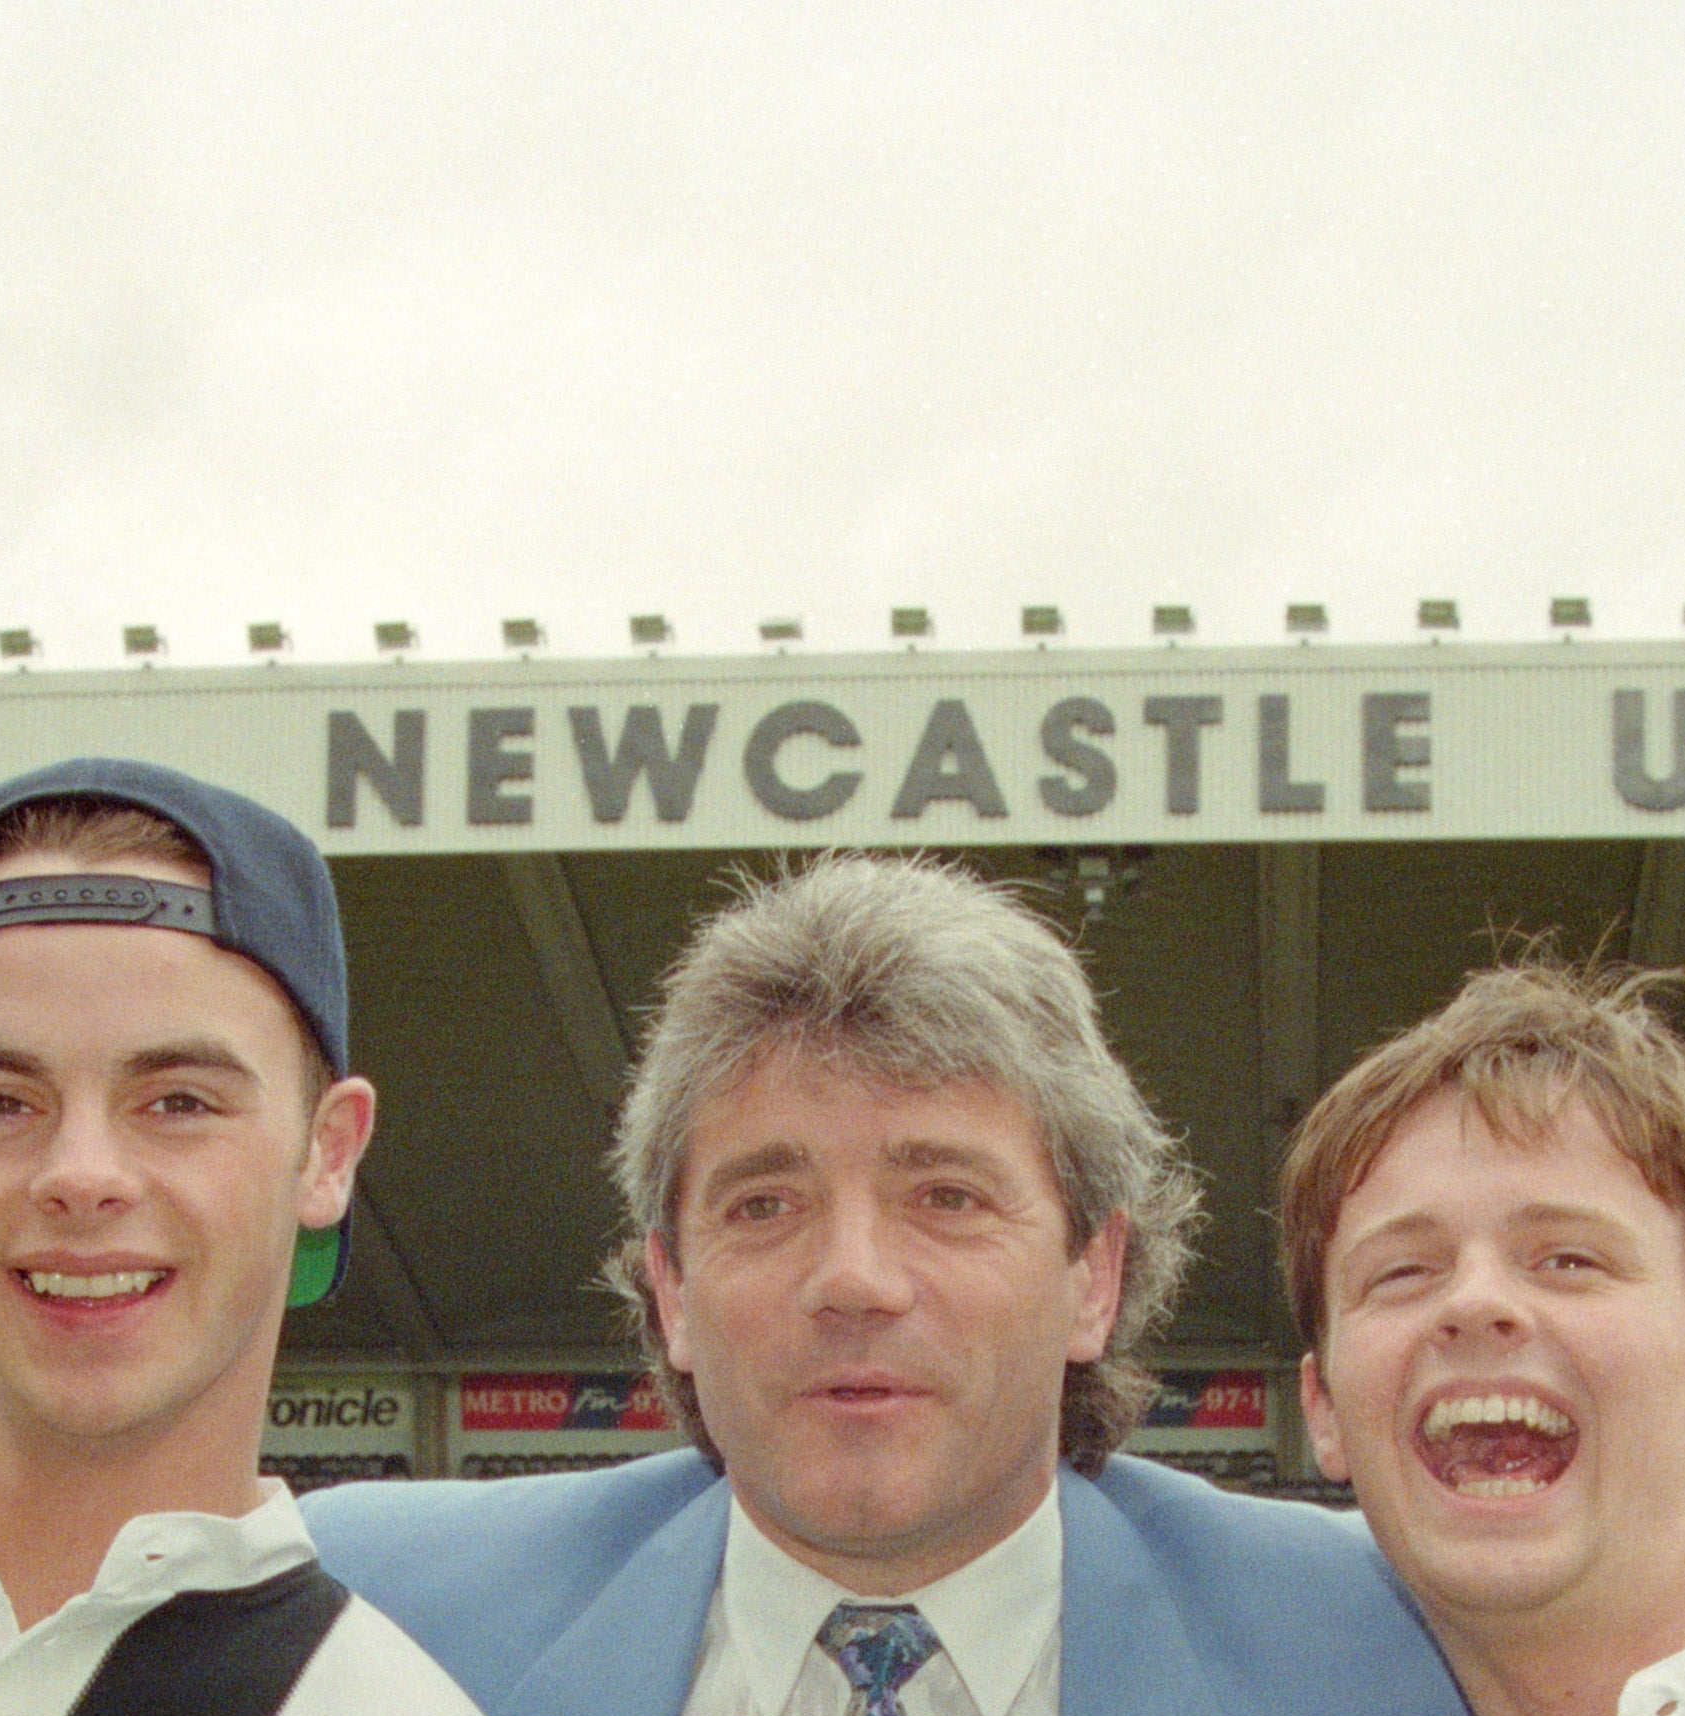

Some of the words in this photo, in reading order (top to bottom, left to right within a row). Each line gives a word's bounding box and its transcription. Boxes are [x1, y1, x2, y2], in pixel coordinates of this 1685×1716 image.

[325, 689, 1433, 827] NEWCASTLE
[271, 1388, 399, 1427] onicle
[464, 1390, 568, 1413] METRO
